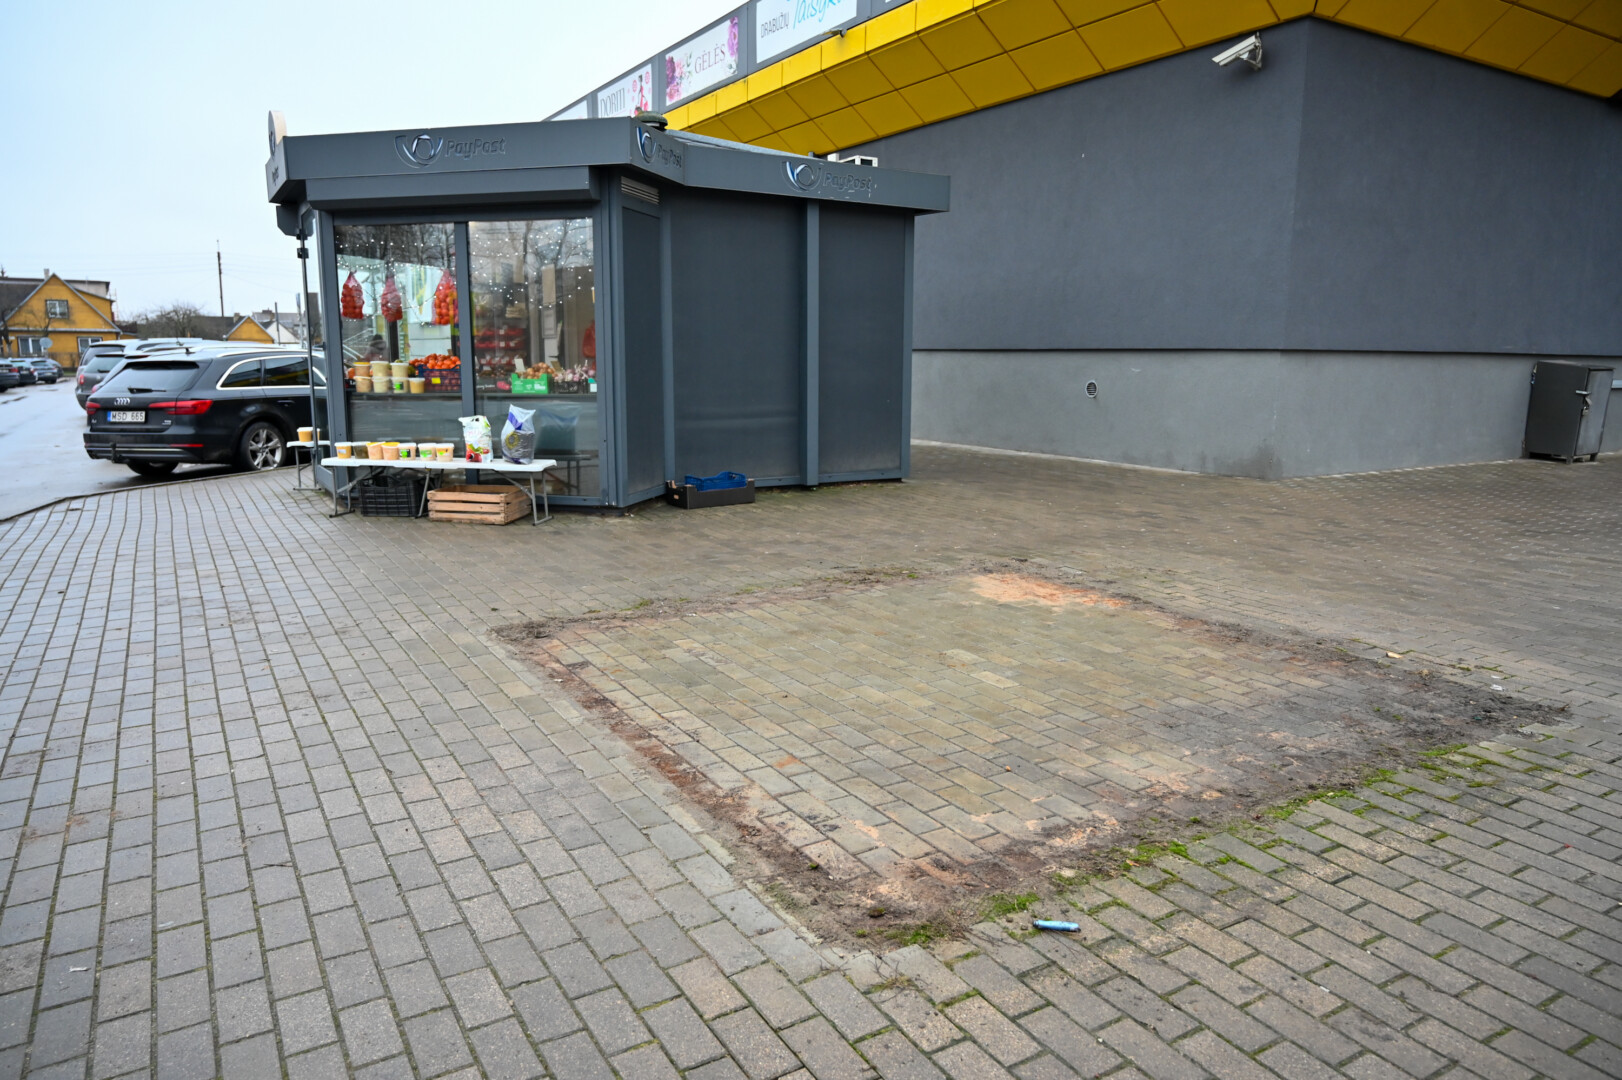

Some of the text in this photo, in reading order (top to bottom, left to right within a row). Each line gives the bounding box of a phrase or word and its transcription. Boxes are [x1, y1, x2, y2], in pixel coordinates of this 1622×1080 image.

[760, 12, 790, 39] DRABUŽIŲ
[694, 43, 726, 74] GĖLĖS
[445, 138, 506, 160] PayPost
[823, 172, 873, 192] PayPost
[111, 410, 144, 420] MSD 665
